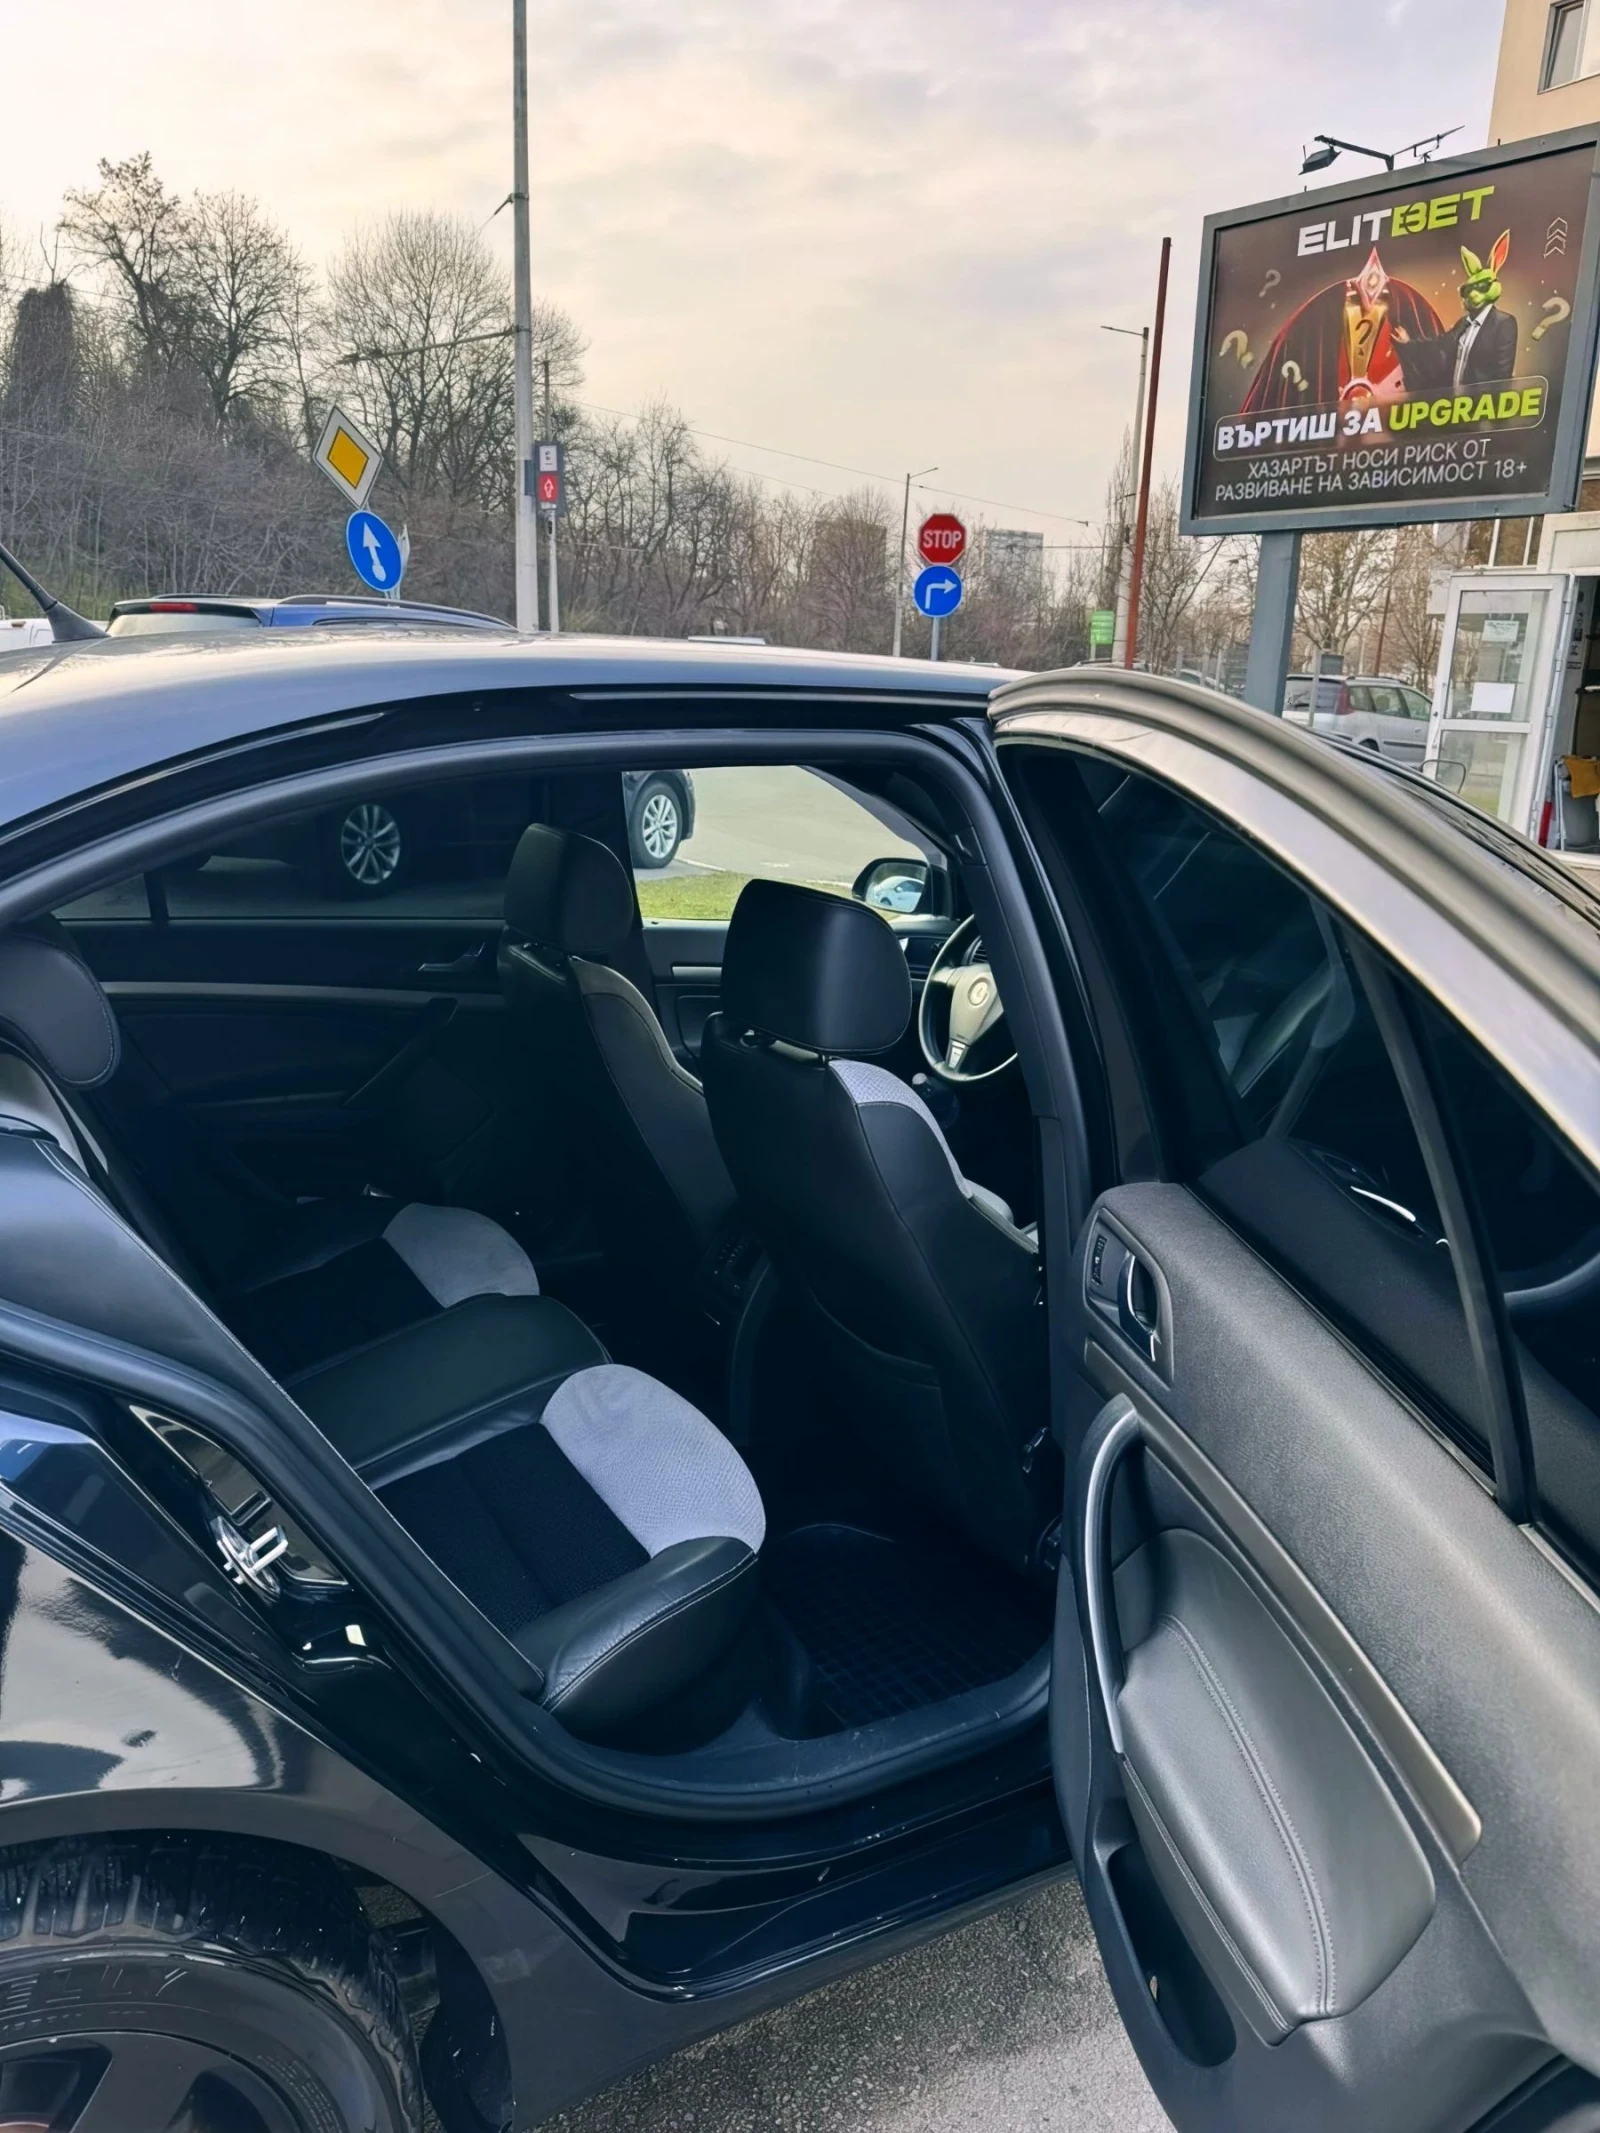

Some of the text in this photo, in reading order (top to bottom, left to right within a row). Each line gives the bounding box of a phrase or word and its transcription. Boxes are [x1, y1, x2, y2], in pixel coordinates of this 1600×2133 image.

[1217, 387, 1543, 451] ВЪРТИШ ЗА UPGRADE
[1215, 458, 1528, 501] РАЗВИВАНЕ НА ЗАВИСИМОСТ 18+
[1247, 438, 1492, 480] ХАЗАРТЪТ НОСИ РИСК ОТ
[923, 530, 962, 549] STOP
